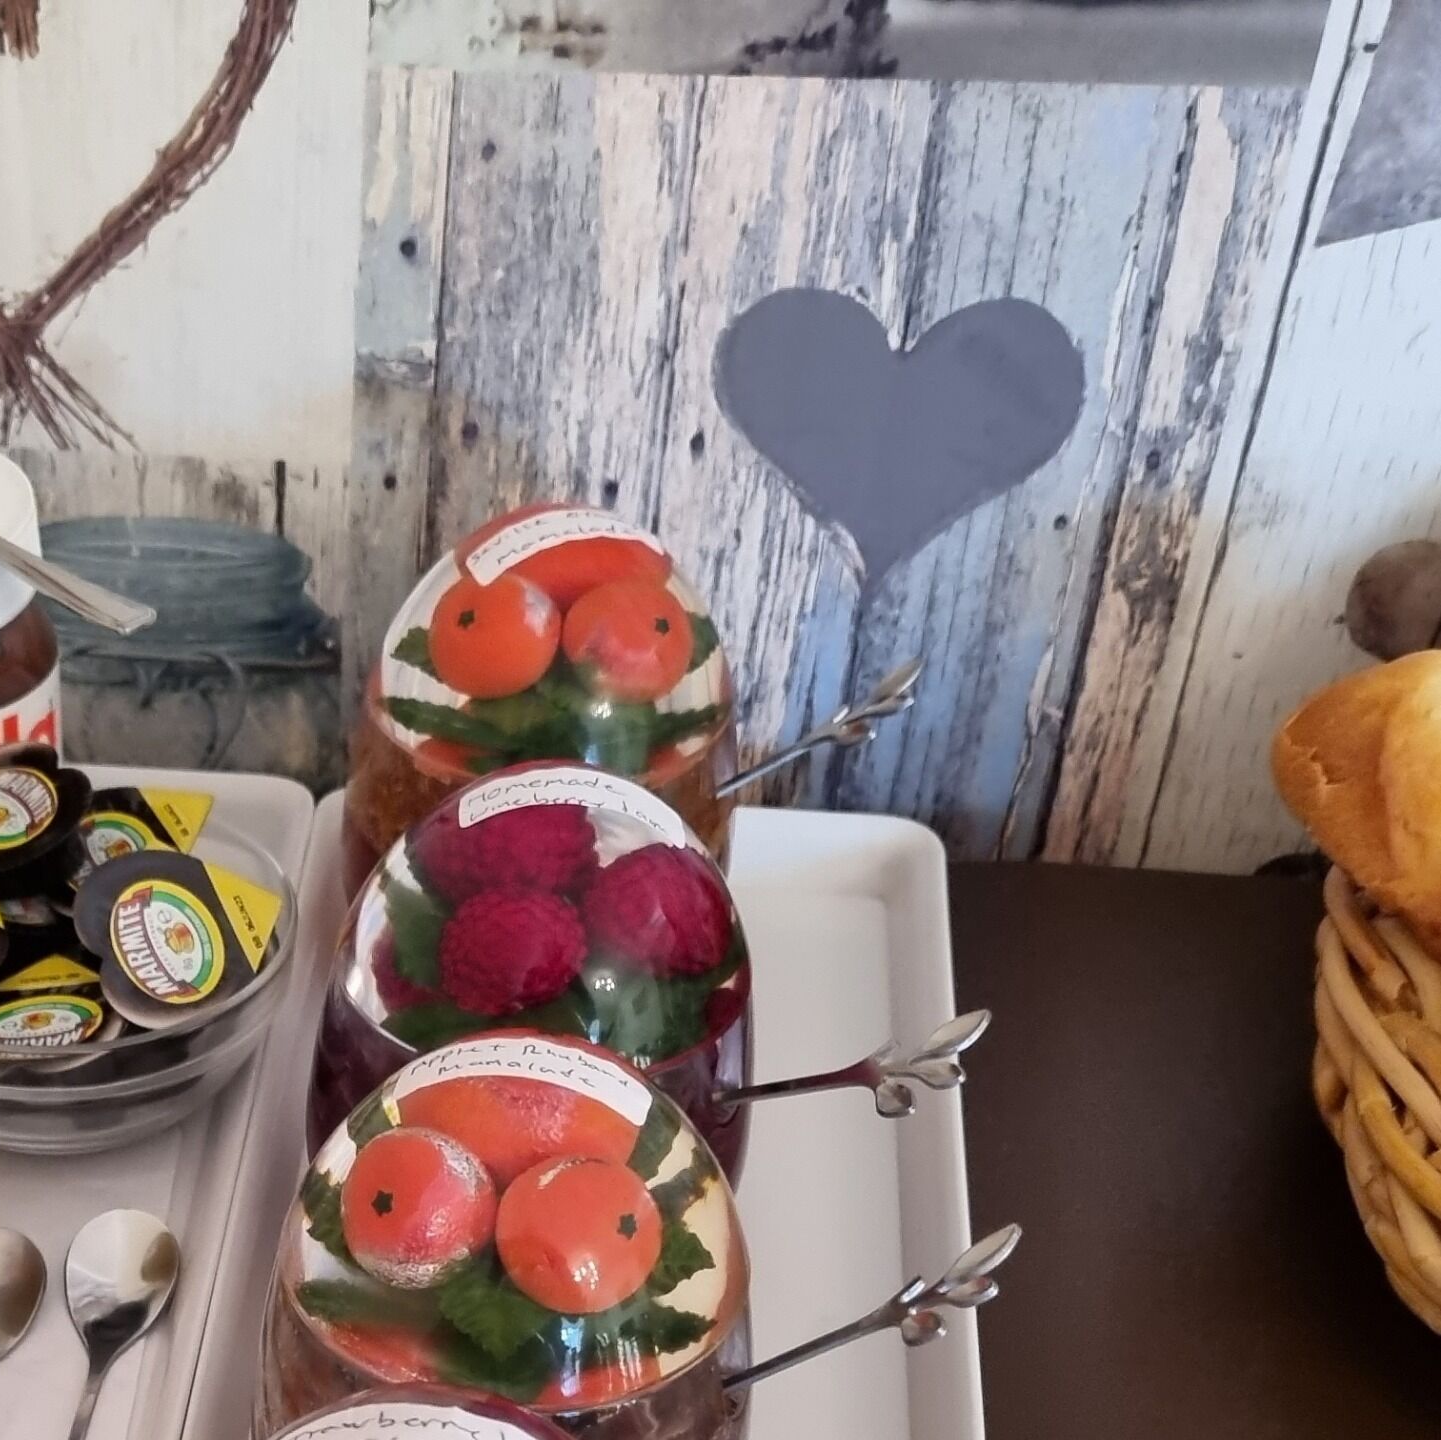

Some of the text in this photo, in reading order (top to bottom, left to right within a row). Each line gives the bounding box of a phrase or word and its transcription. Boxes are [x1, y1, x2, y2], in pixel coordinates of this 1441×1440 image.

[469, 776, 627, 808] Homemade
[117, 901, 181, 996] MARMITE
[410, 1045, 480, 1075] Apple
